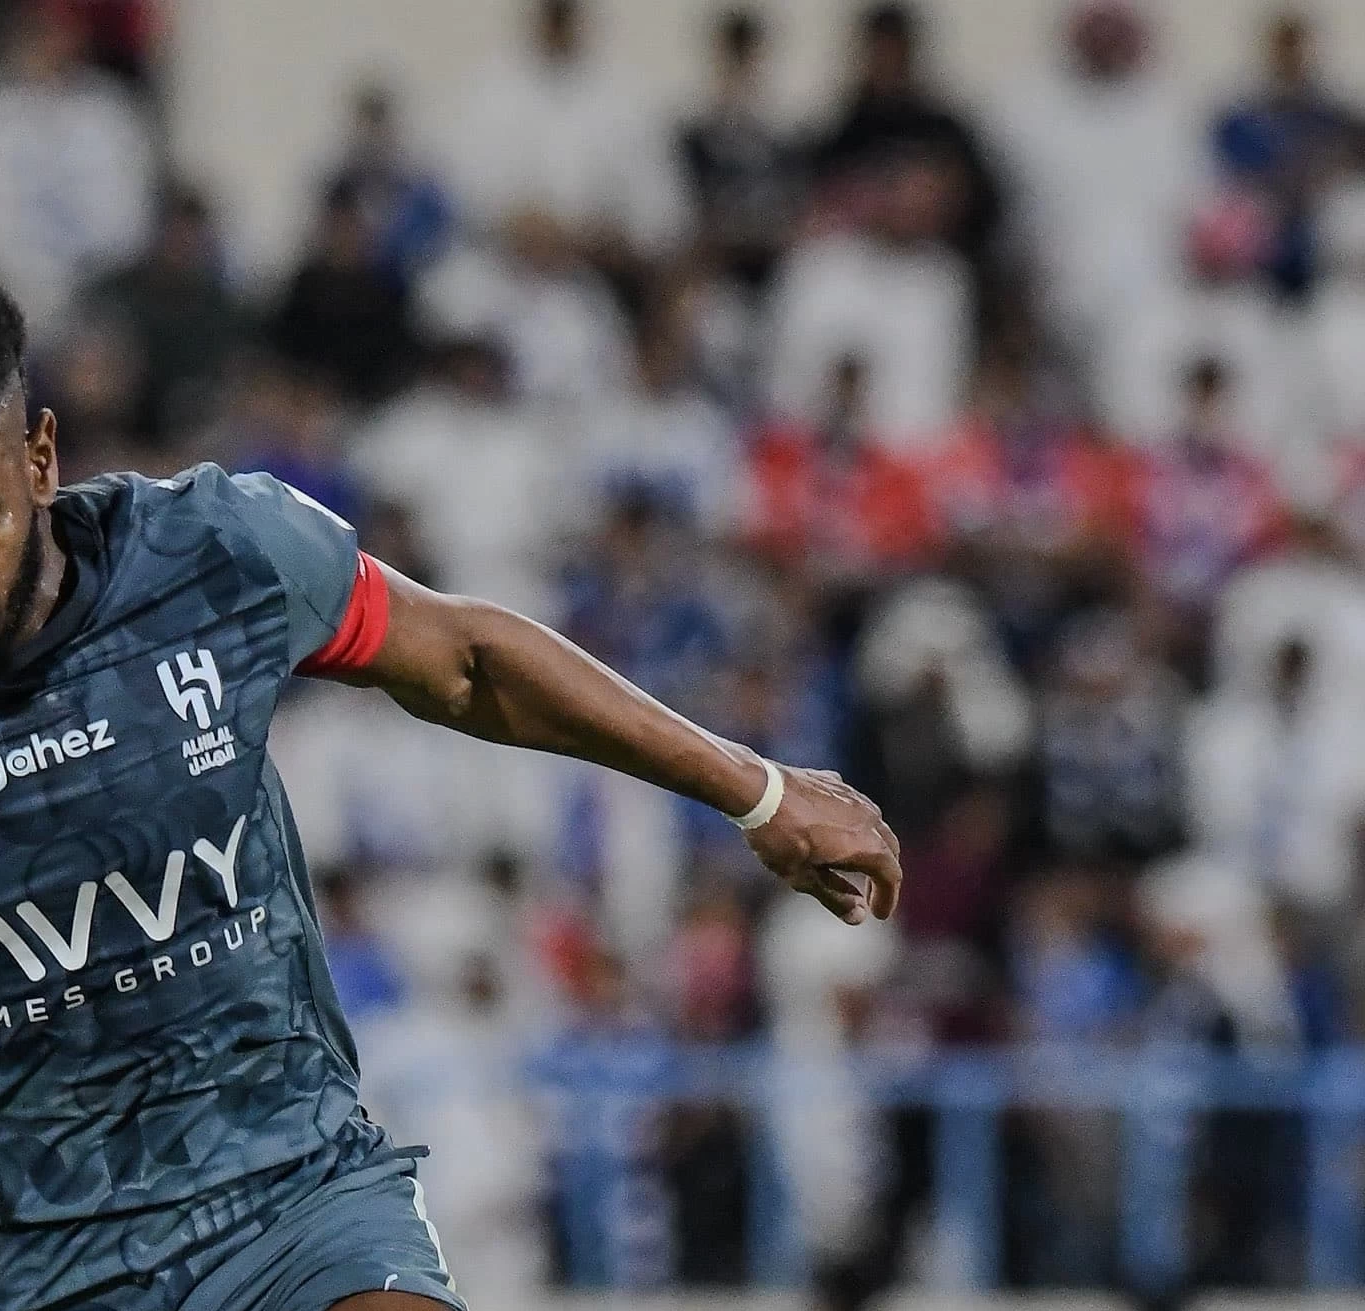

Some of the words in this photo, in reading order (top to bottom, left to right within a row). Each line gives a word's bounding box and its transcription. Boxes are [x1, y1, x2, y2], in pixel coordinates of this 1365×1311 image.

[182, 725, 235, 759] ALHILAL
[188, 743, 236, 777] الهلال
[114, 905, 267, 994] GROUP
